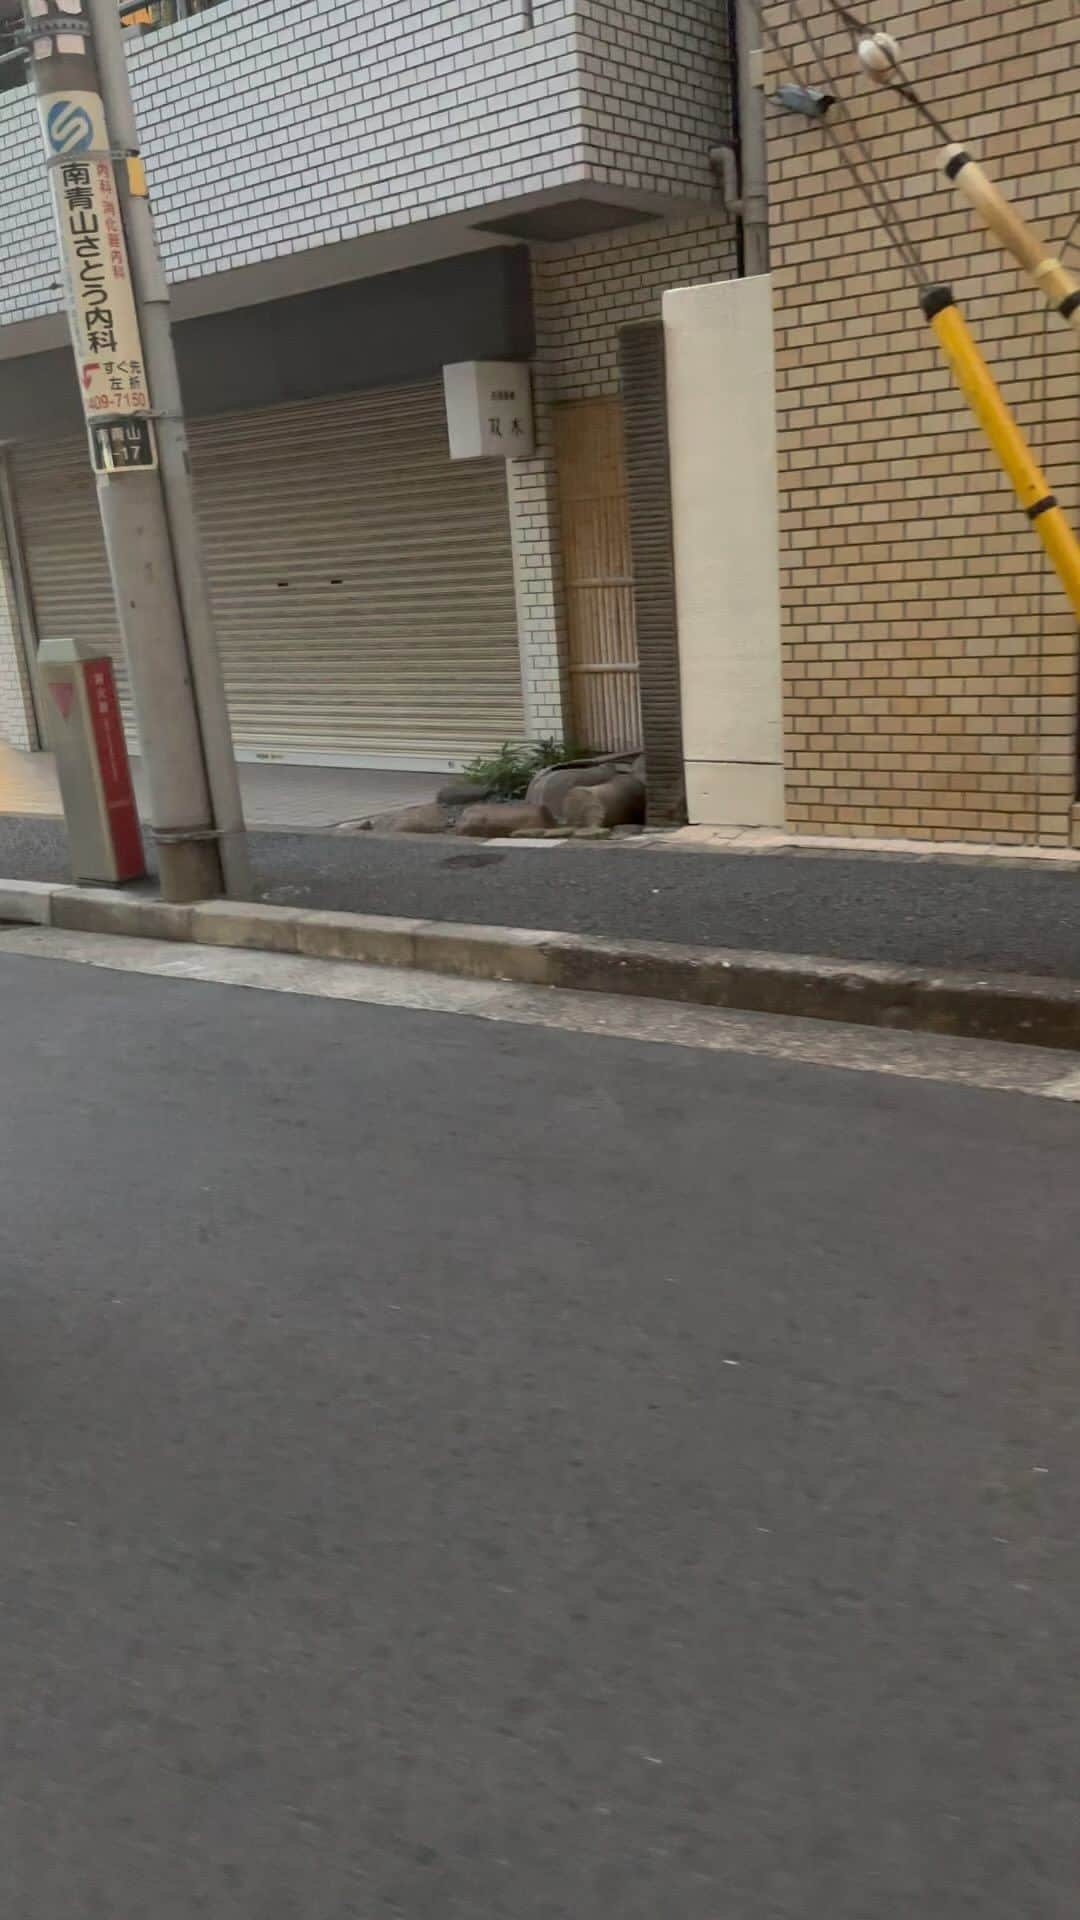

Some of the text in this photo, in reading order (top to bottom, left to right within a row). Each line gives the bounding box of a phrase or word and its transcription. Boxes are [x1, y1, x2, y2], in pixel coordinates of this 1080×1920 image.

[60, 162, 118, 354] 南青山さとう内科
